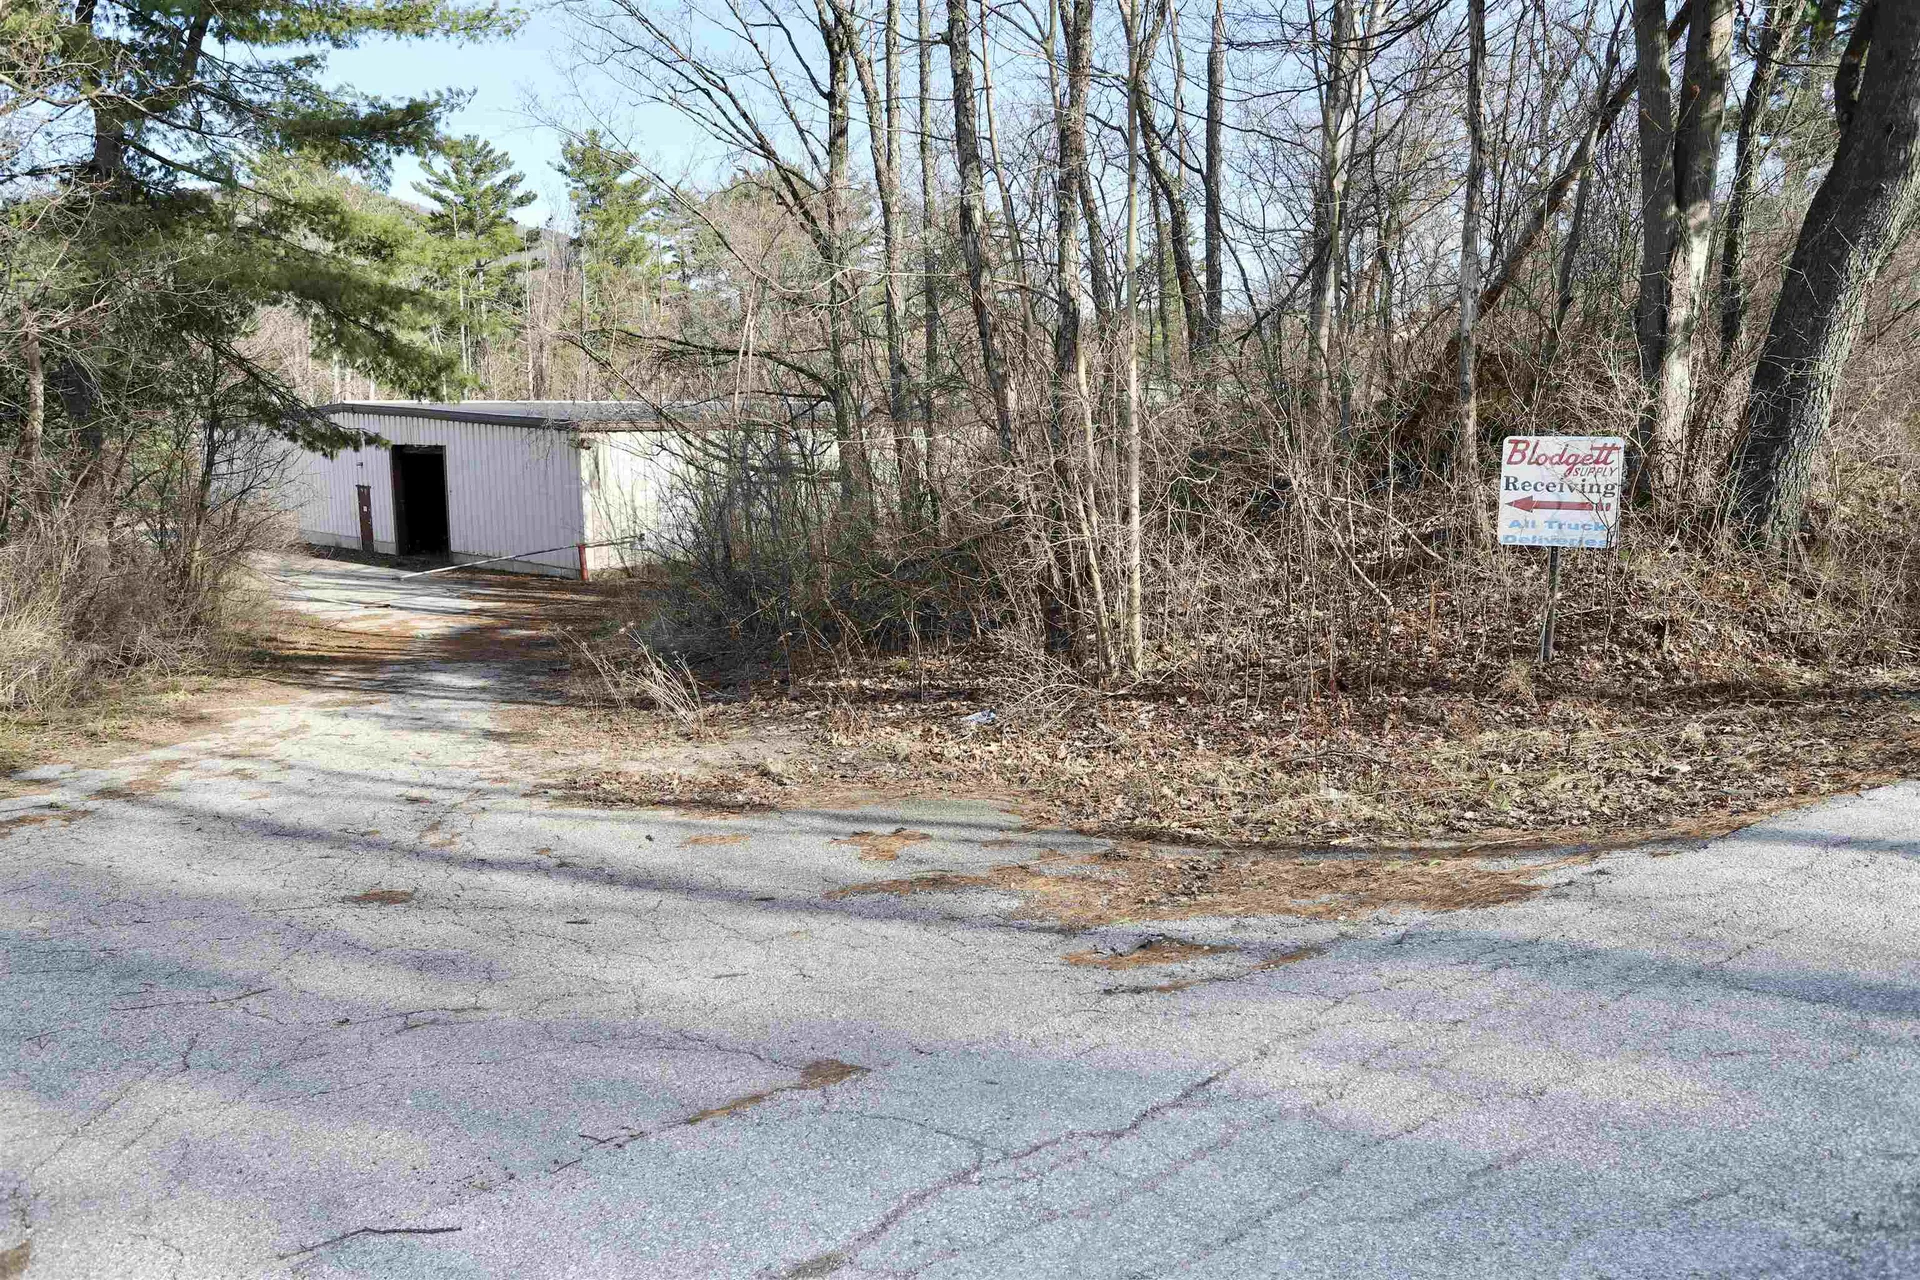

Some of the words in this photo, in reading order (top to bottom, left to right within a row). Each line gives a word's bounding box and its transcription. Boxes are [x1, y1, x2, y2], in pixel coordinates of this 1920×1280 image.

[1506, 439, 1621, 478] Blodgett
[1573, 467, 1618, 477] SUPPLY
[1503, 475, 1617, 498] Receiving
[1509, 519, 1536, 529] All
[1544, 520, 1607, 531] Truck
[1503, 534, 1607, 547] Deliveries
